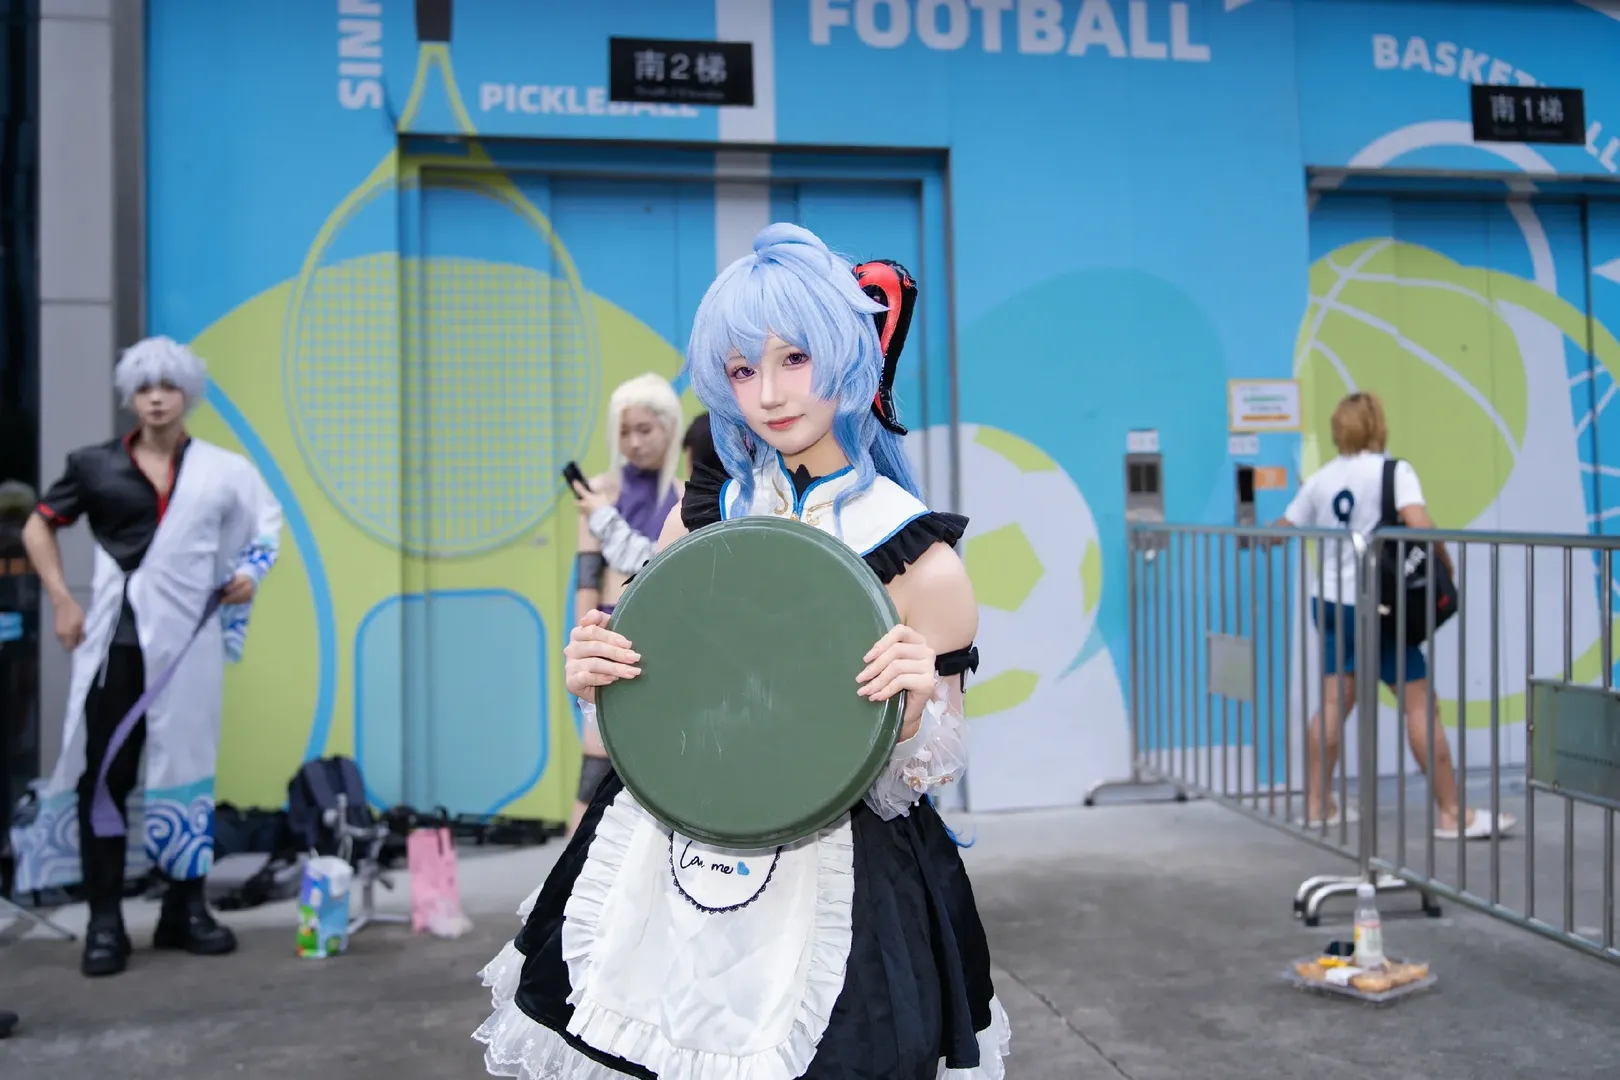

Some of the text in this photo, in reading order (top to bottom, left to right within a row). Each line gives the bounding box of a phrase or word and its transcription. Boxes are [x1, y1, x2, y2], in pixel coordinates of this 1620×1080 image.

[809, 0, 1211, 62] FOOTBALL
[633, 49, 727, 84] 南2梯
[1372, 33, 1620, 173] BASKETLL
[711, 863, 734, 874] me
